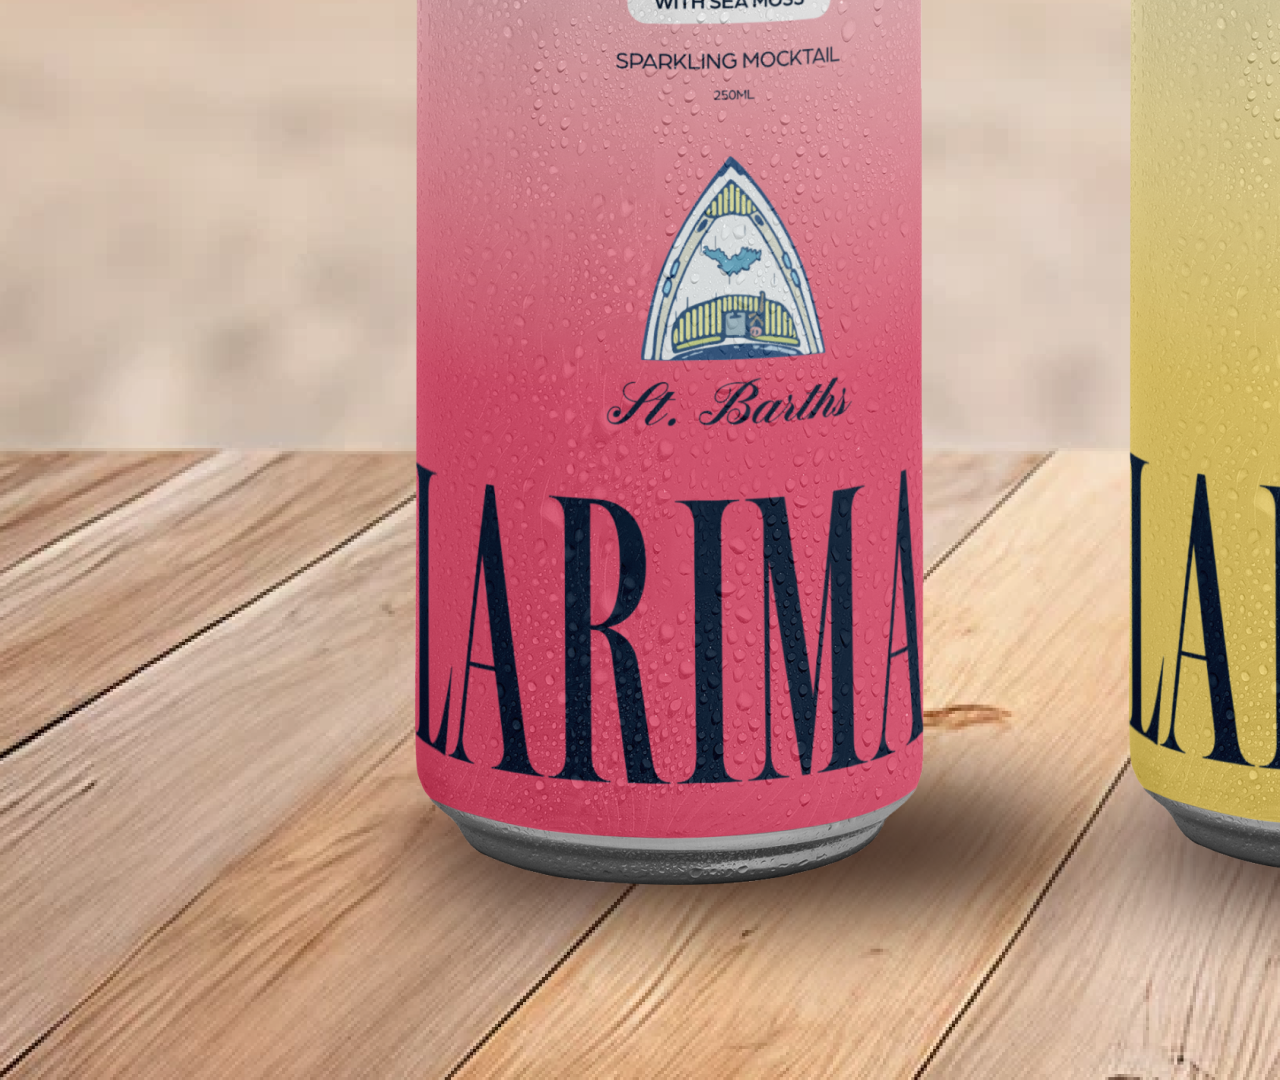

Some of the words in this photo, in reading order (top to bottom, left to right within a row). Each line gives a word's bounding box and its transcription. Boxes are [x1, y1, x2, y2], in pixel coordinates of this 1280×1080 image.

[615, 52, 738, 71] SPARKLING
[742, 47, 840, 69] MOCKTAIL
[713, 89, 755, 101] 250ML
[606, 381, 677, 427] St.
[699, 377, 852, 426] Barths
[416, 461, 922, 785] LARIMA
